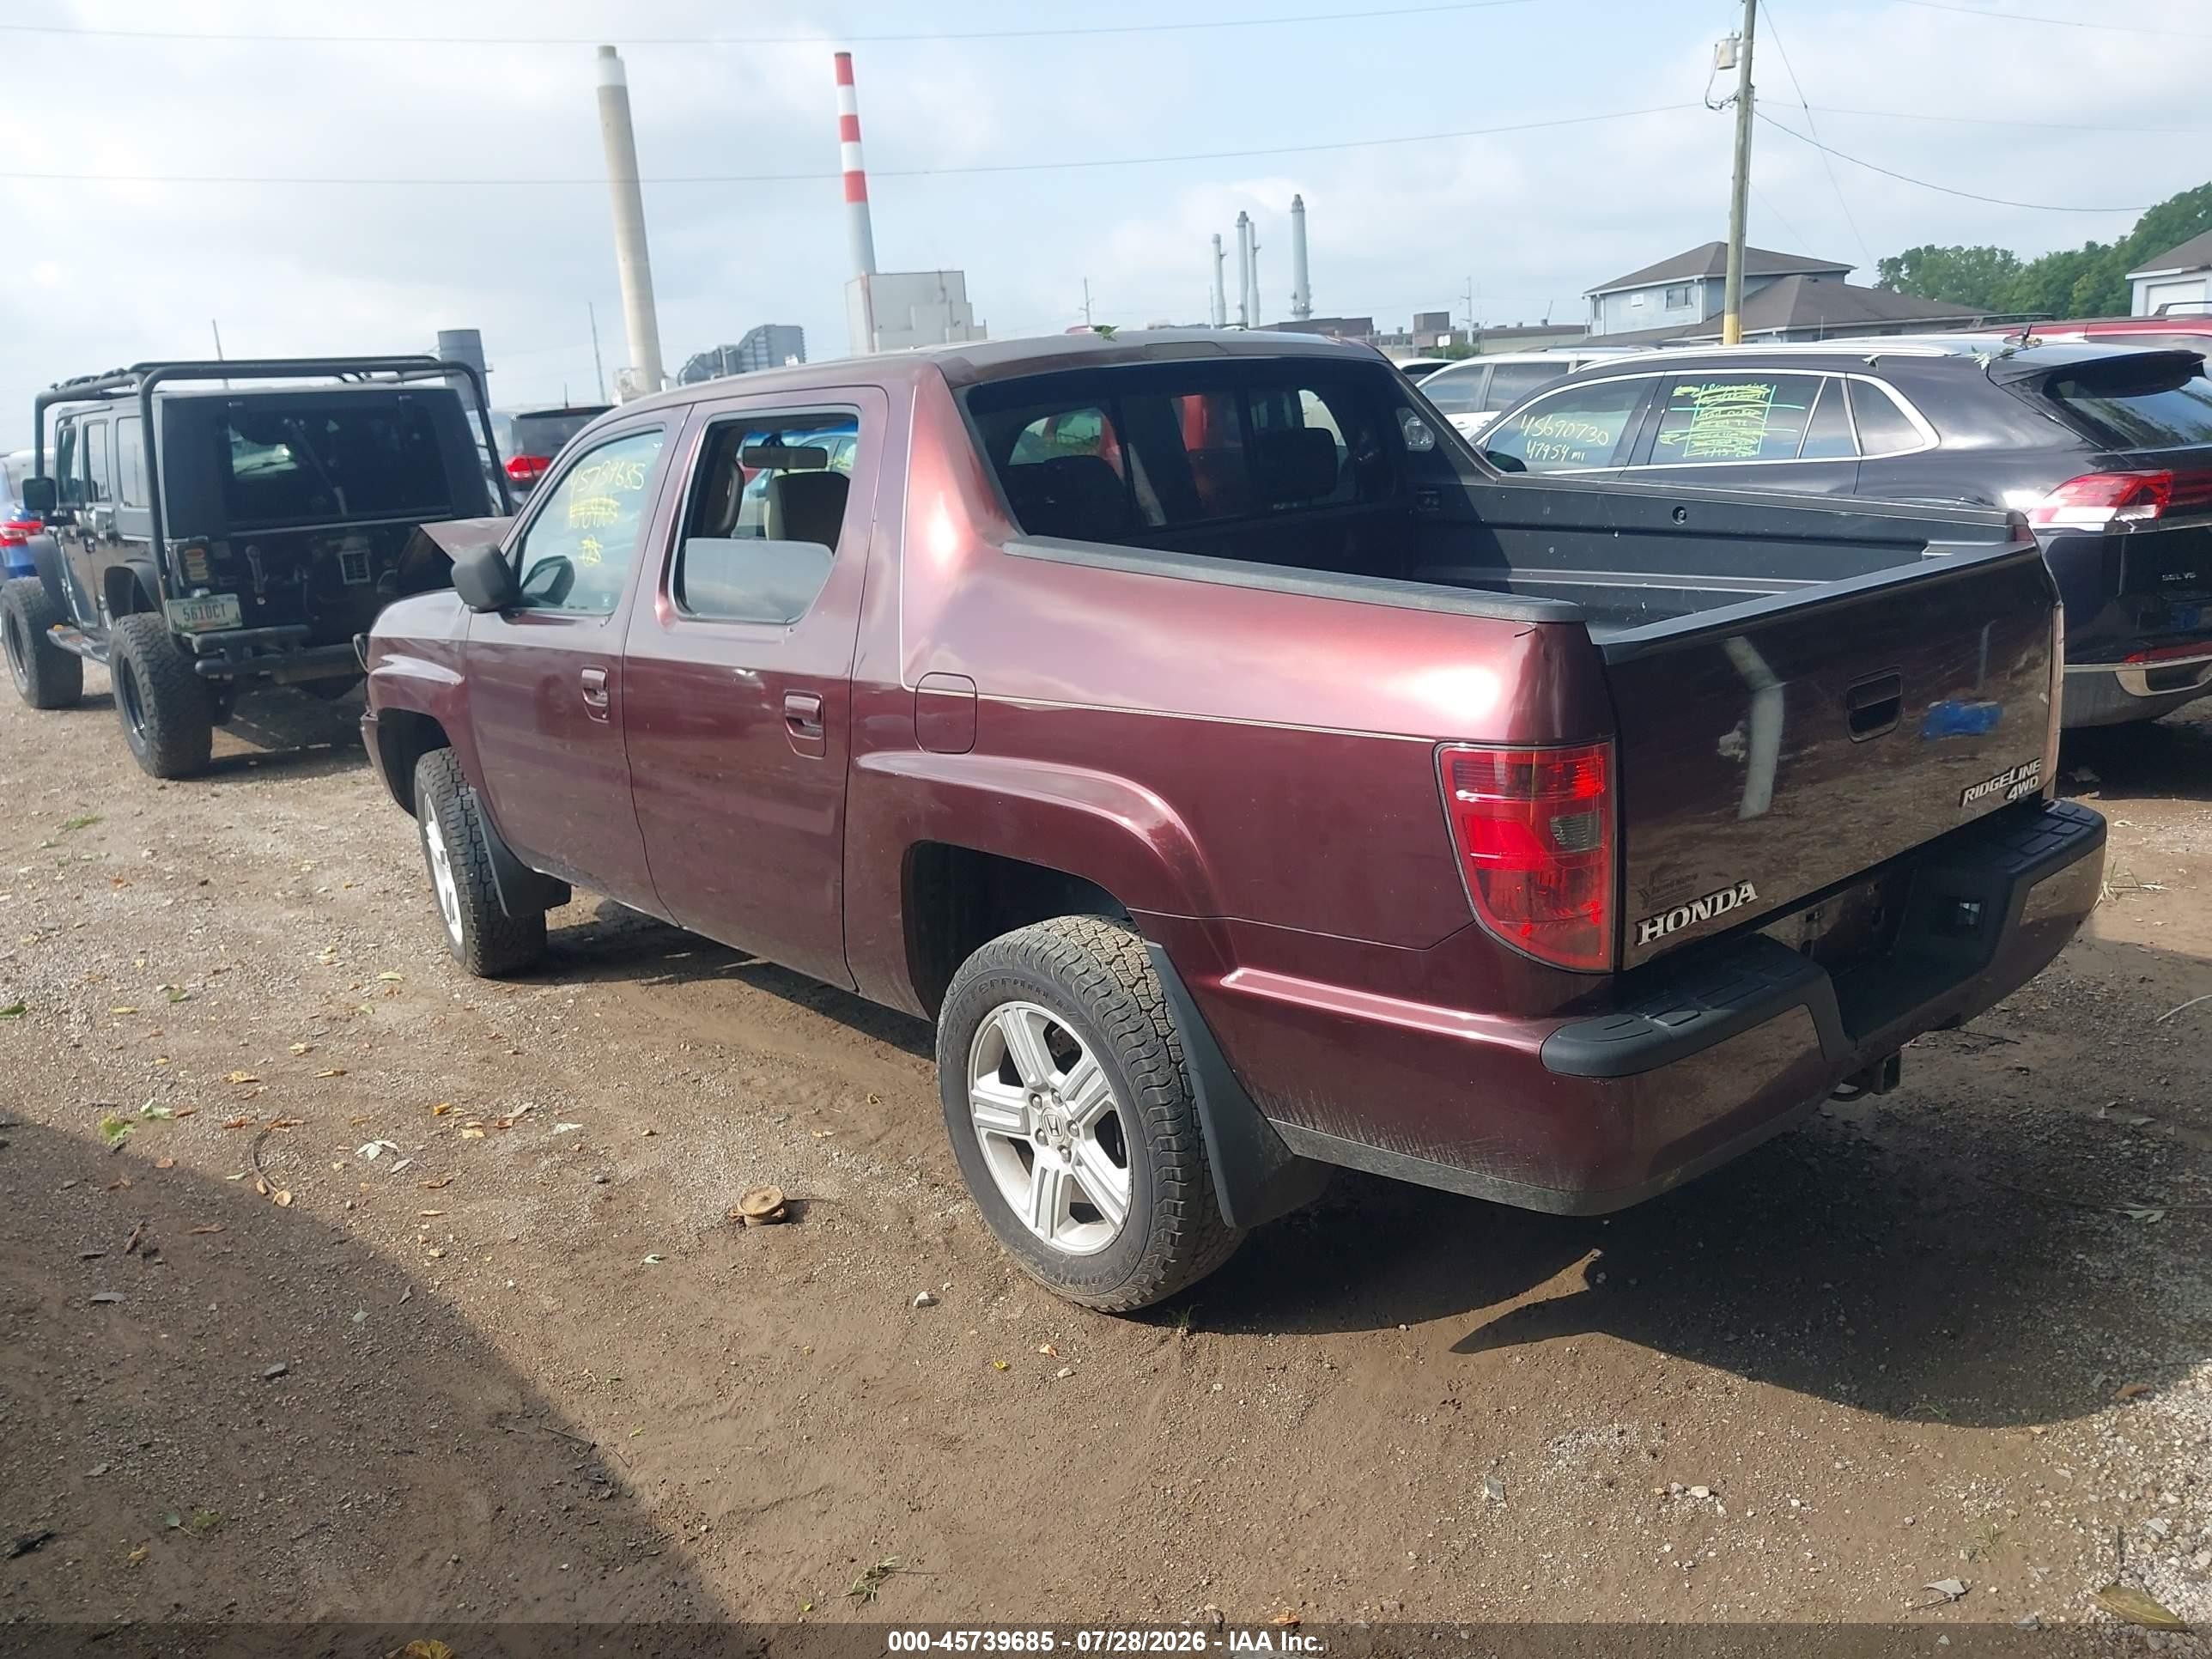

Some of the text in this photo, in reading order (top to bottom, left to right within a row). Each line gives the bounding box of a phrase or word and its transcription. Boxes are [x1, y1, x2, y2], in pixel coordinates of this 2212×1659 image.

[1520, 414, 1608, 446] 45690730
[1526, 440, 1570, 461] 47954
[1960, 757, 2042, 807] RIDGELINE
[2006, 775, 2039, 800] 4WD
[1636, 880, 1759, 946] HONDA
